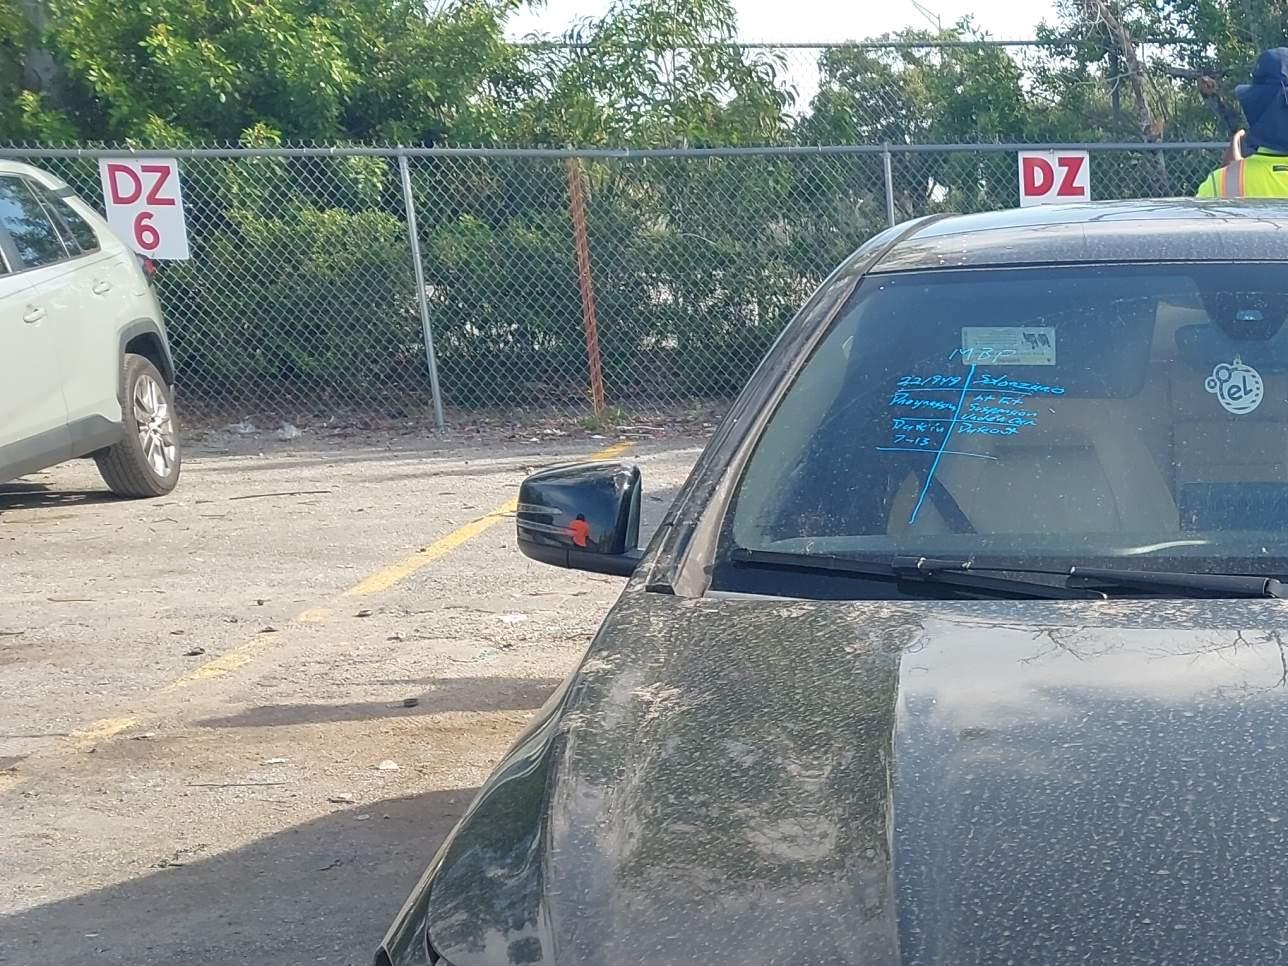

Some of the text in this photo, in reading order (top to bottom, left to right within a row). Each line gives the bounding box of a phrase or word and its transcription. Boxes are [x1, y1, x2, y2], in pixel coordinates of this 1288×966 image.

[107, 164, 176, 205] DZ
[1023, 157, 1085, 196] DZ
[134, 211, 160, 250] 6
